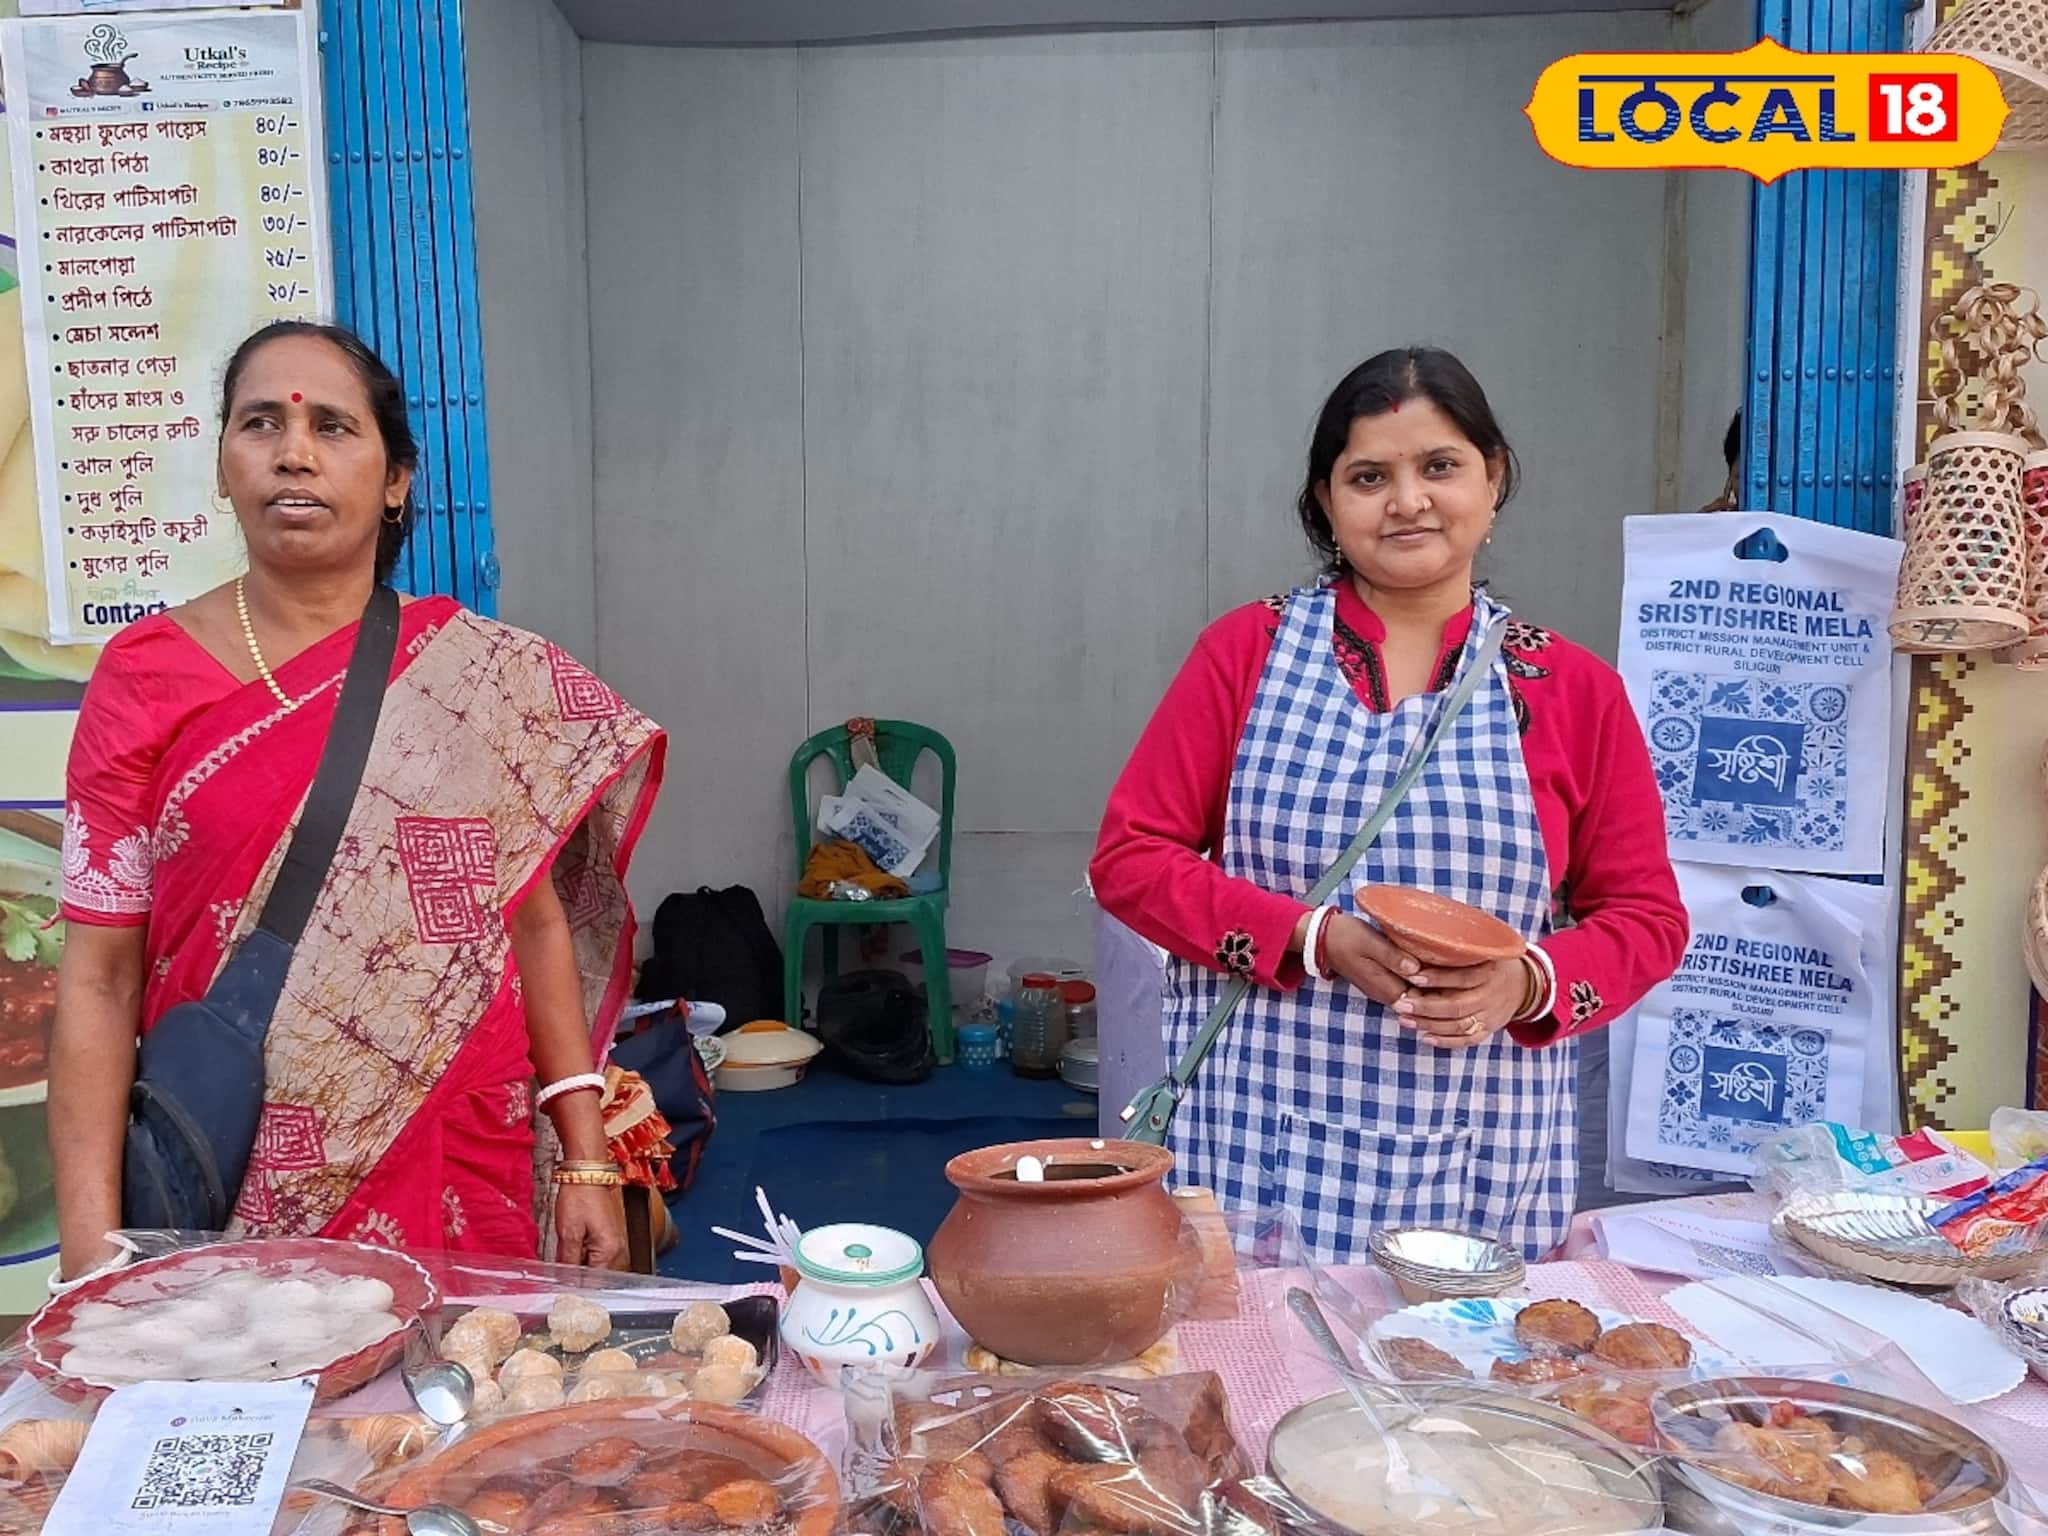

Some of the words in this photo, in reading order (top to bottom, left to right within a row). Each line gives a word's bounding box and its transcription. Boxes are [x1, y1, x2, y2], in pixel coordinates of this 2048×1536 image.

[184, 46, 247, 61] Utkal's
[197, 61, 237, 70] Recipe
[49, 124, 91, 144] মহুয়া
[99, 123, 149, 148] ফুলের
[156, 121, 207, 140] পায়েস
[112, 152, 149, 173] পিঠা
[113, 184, 198, 208] পাটিসাপটা
[55, 225, 145, 244] নারকেলের
[152, 216, 237, 239] পাটিসাপটা
[57, 256, 135, 276] মালপোয়া
[62, 287, 106, 311] প্রদীপ
[113, 285, 152, 307] পিঠে
[108, 323, 160, 342] সন্দেশ
[67, 359, 129, 378] ছাতনার
[136, 356, 177, 376] পেড়া
[69, 386, 118, 410] হাঁসের
[124, 391, 162, 407] মাংস
[170, 390, 185, 405] ও
[72, 426, 100, 443] সরু
[106, 424, 159, 442] চালের
[165, 416, 200, 440] রুটি
[74, 458, 112, 475] ঝাল
[120, 451, 153, 480] পুলি
[77, 492, 101, 514] দুধ
[109, 484, 143, 512] পুলি
[82, 557, 128, 579] মুগের
[135, 549, 169, 577] পুলি
[1668, 580, 1721, 601] 2ND
[1728, 581, 1844, 613] REGIONAL
[1638, 603, 1798, 634] SRISTISHREE
[1805, 615, 1873, 639] MELA
[1640, 627, 1695, 640] DISTRICT
[1698, 631, 1749, 644] MISSION
[1830, 641, 1859, 653] UNIT
[1645, 640, 1701, 653] DISTRICT
[1704, 645, 1746, 657] RURAL
[1750, 648, 1829, 665] DEVELOPMENT
[1833, 655, 1864, 666] CELL
[1693, 933, 1728, 951] 2ND
[1735, 938, 1833, 968] REGIONAL
[1681, 953, 1794, 982] RISTISHREE
[1799, 969, 1853, 992] MELA
[1709, 987, 1743, 1001] RURAL
